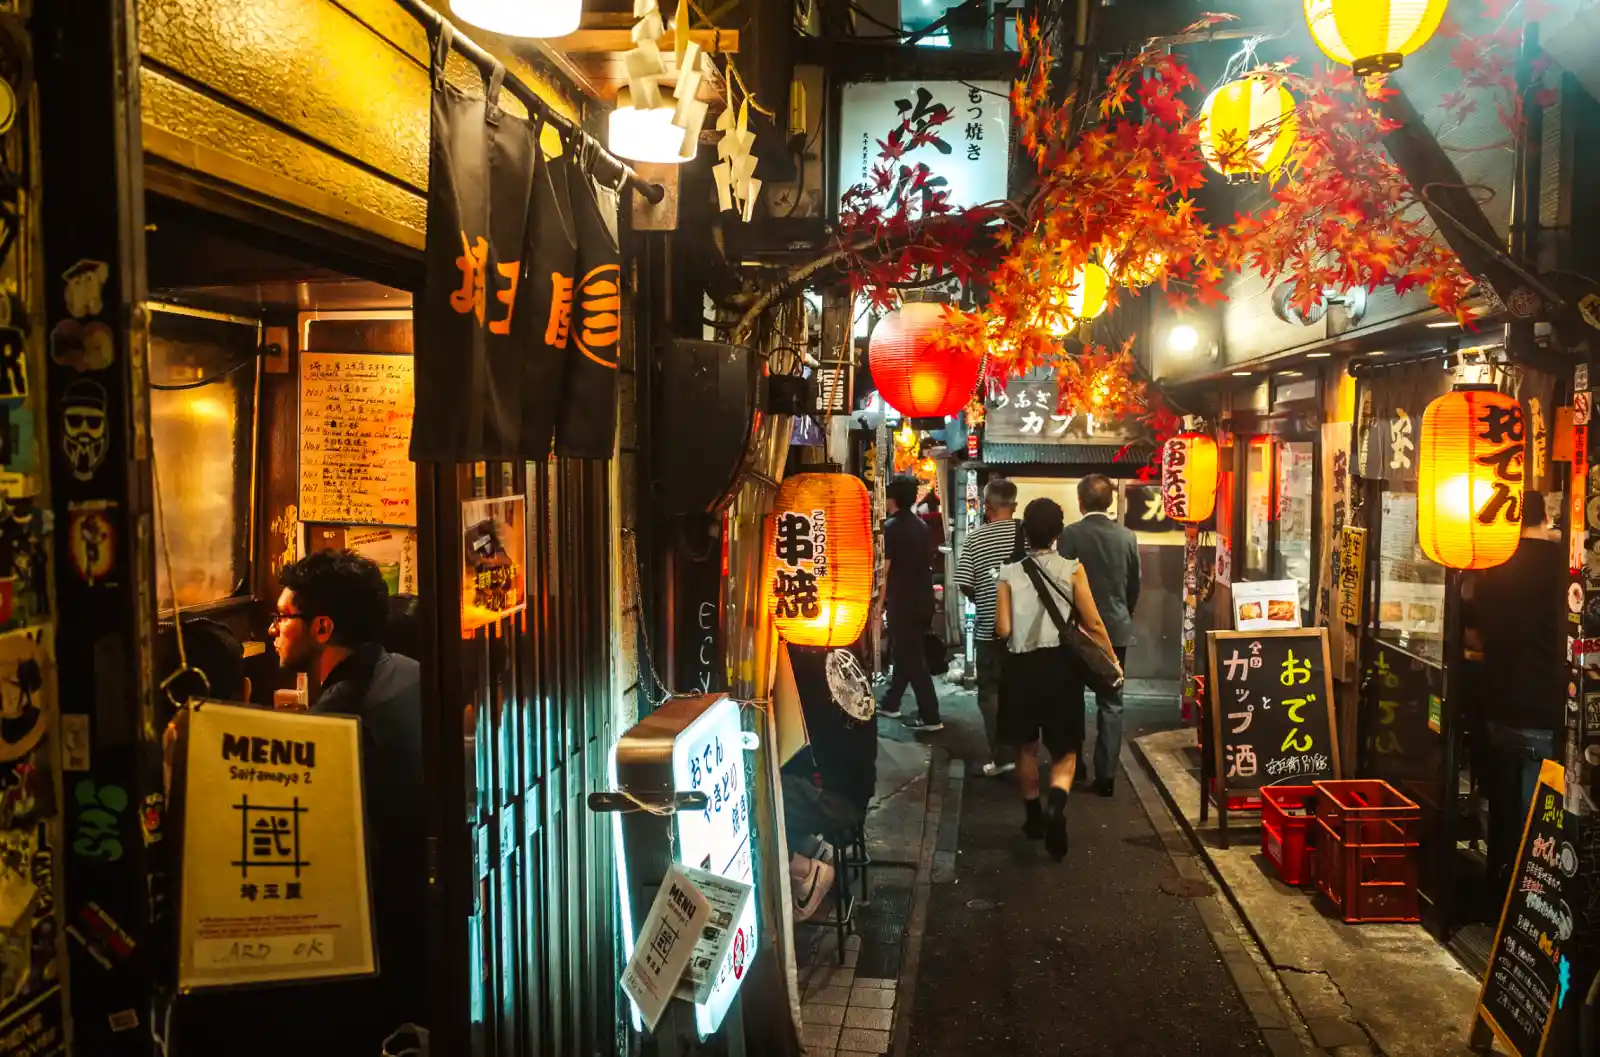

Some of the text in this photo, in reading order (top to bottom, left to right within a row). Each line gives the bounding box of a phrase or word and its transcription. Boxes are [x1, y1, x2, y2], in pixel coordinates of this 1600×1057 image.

[965, 87, 984, 161] もつ焼き
[1475, 403, 1525, 526] おでん
[773, 512, 822, 619] 串焼
[1222, 648, 1258, 778] カップ酒
[1261, 696, 1272, 710] と
[1279, 648, 1317, 752] おでん
[221, 732, 316, 769] MENU
[691, 735, 724, 789] おでん
[669, 883, 698, 920] MENU
